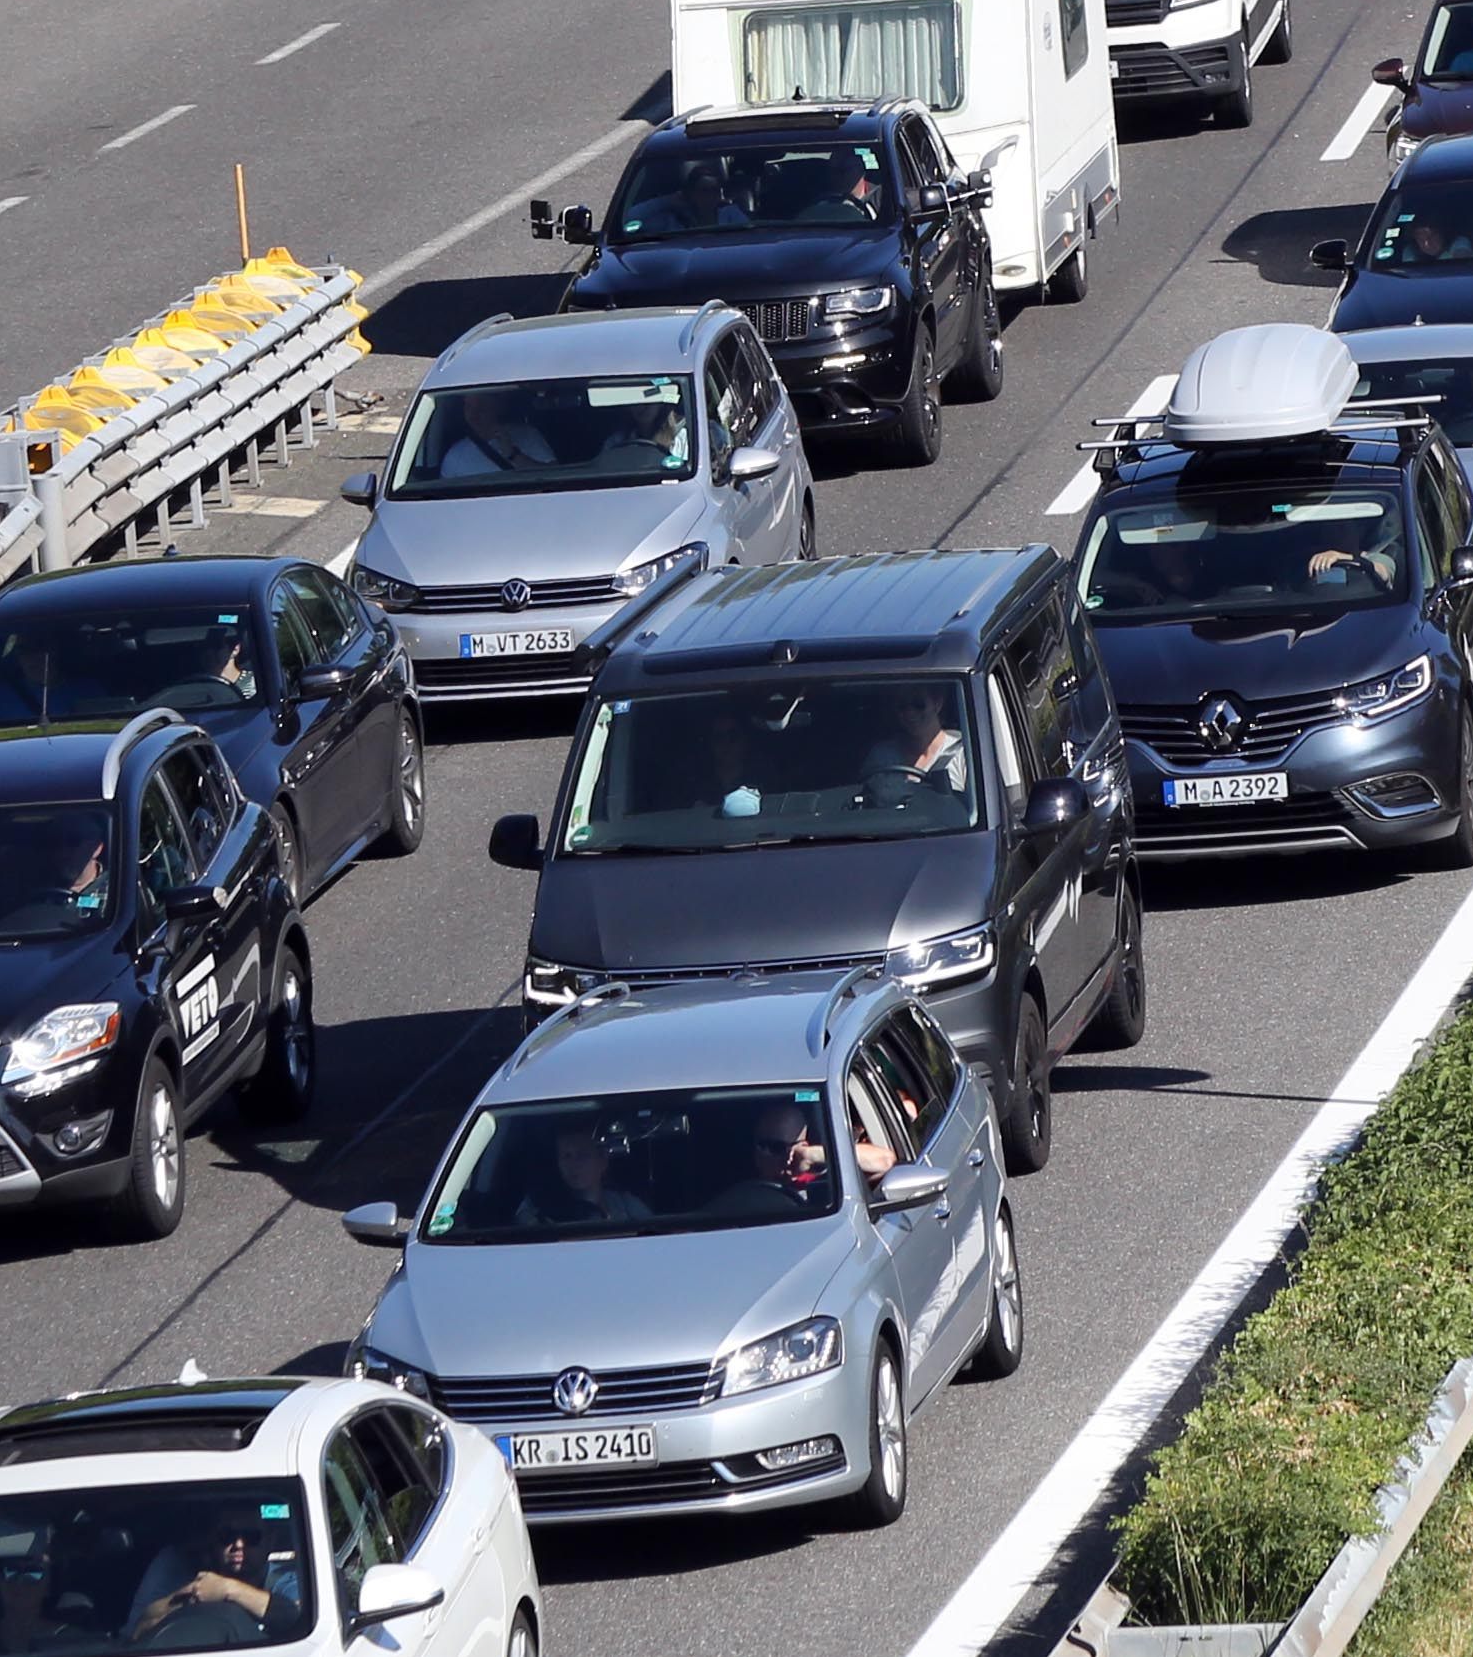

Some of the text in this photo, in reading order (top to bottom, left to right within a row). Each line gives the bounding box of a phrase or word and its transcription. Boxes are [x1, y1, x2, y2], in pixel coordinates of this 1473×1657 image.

[472, 631, 570, 654] M VT 2633
[1184, 781, 1198, 801] M
[1212, 780, 1224, 799] A
[1229, 776, 1279, 798] 2392
[179, 975, 219, 1040] VETO
[513, 1431, 651, 1465] KR IS 2410
